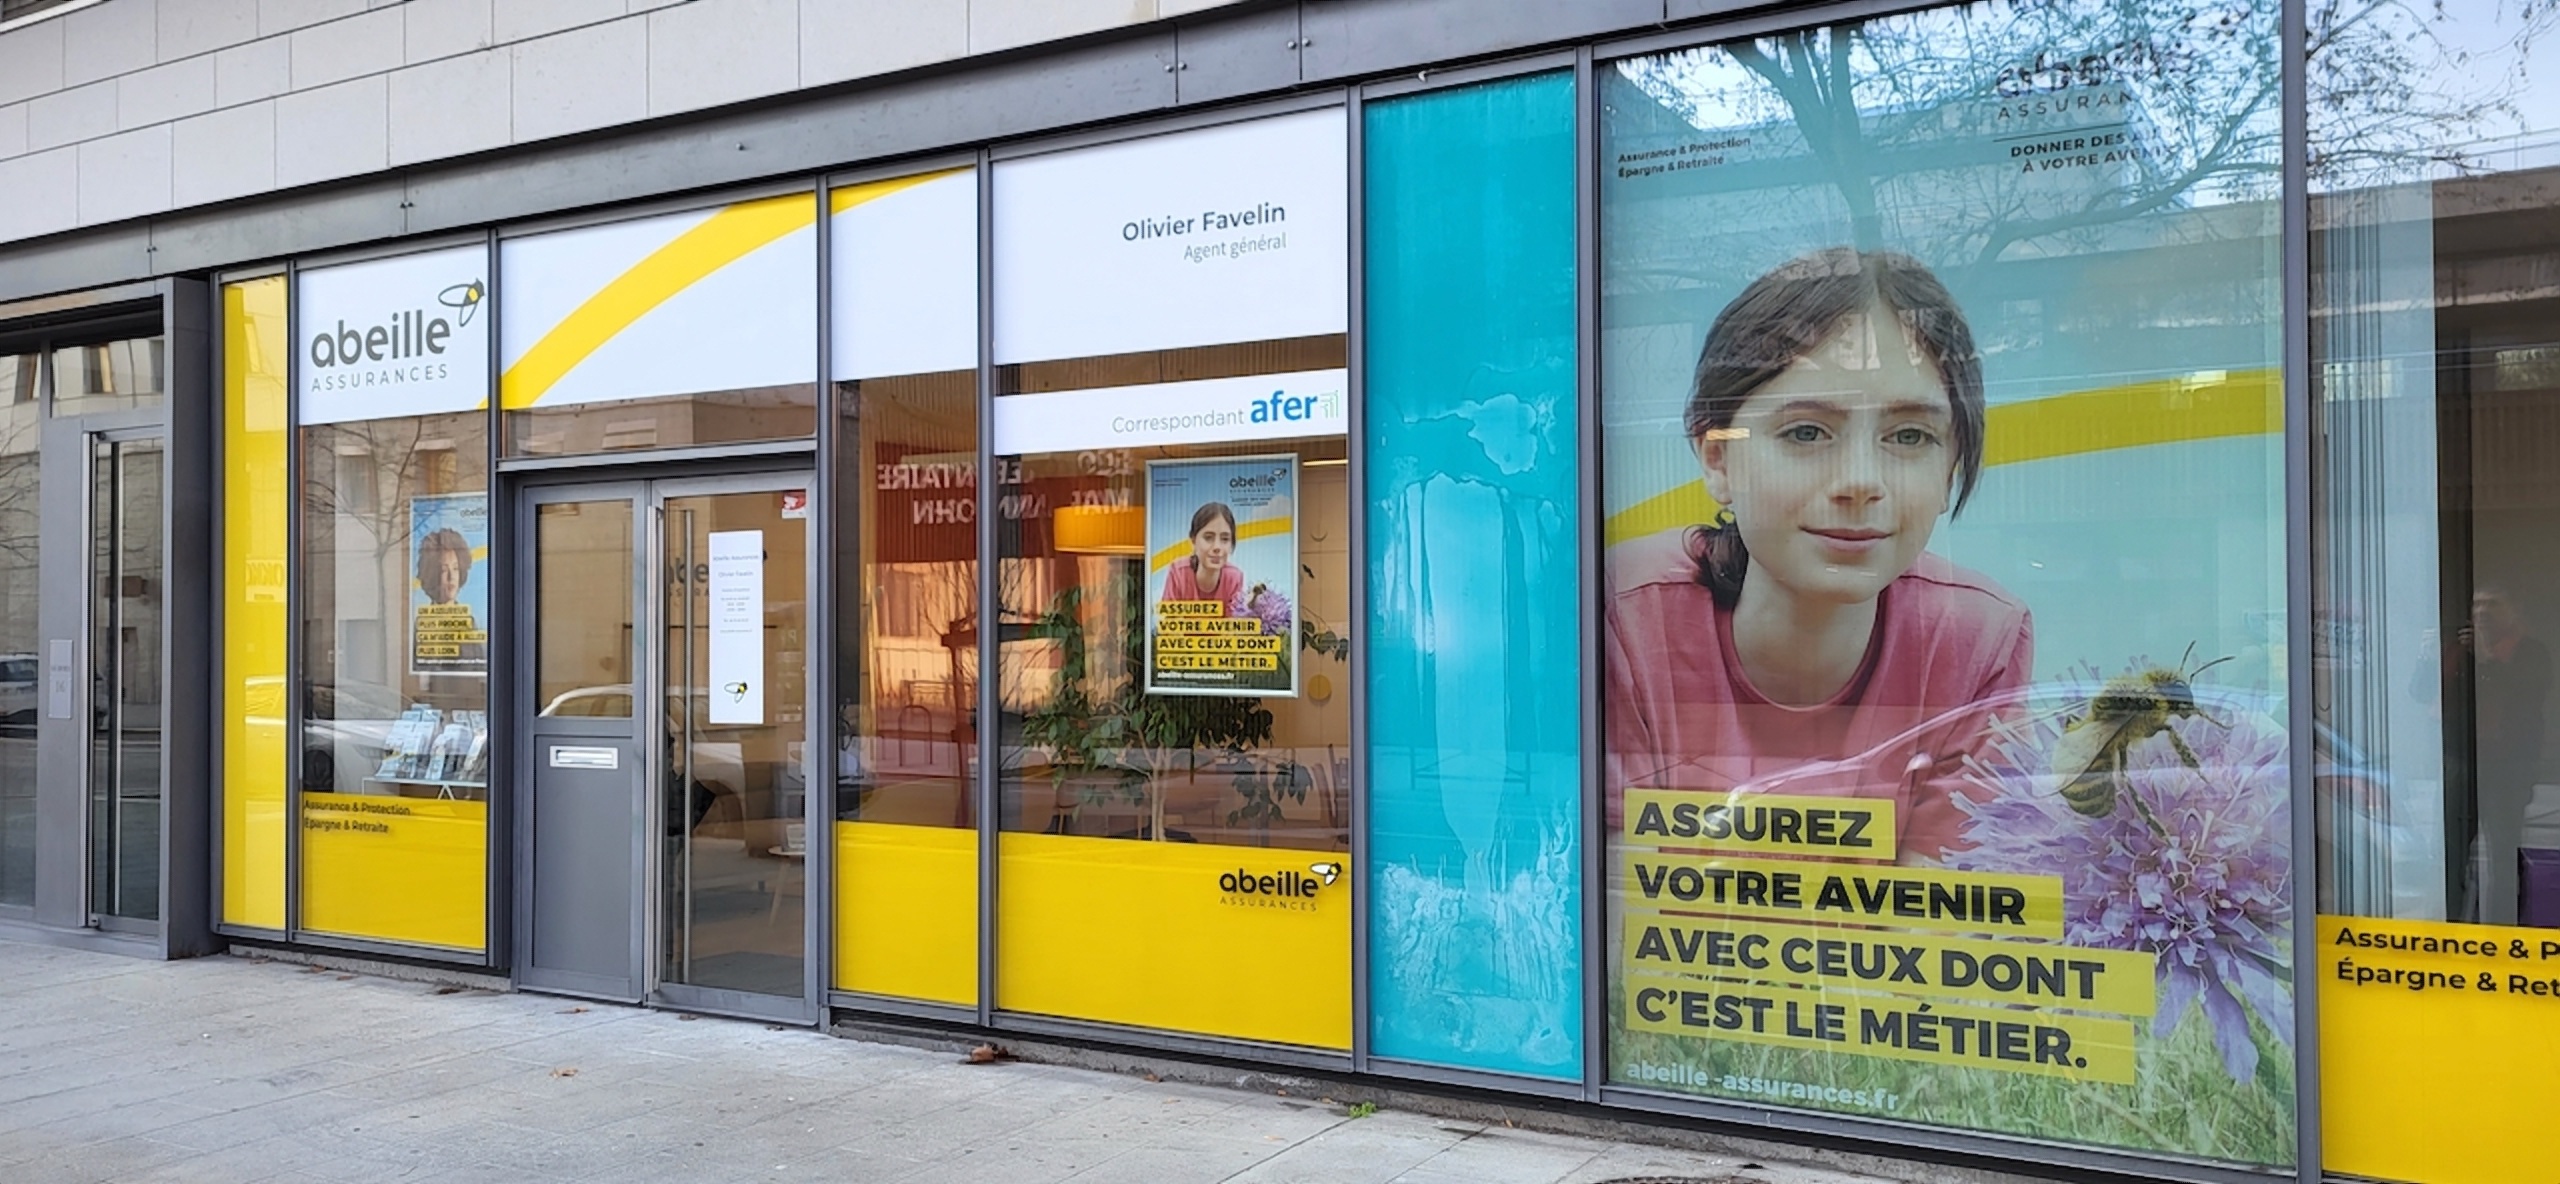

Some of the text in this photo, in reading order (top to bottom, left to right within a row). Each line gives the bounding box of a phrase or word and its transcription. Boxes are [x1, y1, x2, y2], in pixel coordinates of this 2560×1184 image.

[1618, 136, 1751, 164] Assurance & Protection
[2011, 138, 2086, 158] DONNER
[2090, 132, 2126, 148] DES
[1618, 155, 1725, 180] Épargne & Retraite
[2022, 158, 2034, 175] À
[2039, 153, 2100, 171] VOTRE
[1122, 201, 1286, 242] Olivier Favelin
[1184, 231, 1287, 264] Agent général
[311, 308, 451, 369] abeille
[311, 362, 448, 393] ASSURANCES
[1111, 389, 1318, 433] Correspondant afer
[1160, 603, 1219, 615] ASSUREZ
[1159, 620, 1256, 632] VOTRE AVENIR
[1159, 638, 1276, 650] AVEC CEUX DONT
[1199, 656, 1217, 668] LE
[303, 800, 411, 816] Assurance & Protection
[343, 820, 350, 831] &
[352, 820, 389, 833] Retraite
[1634, 801, 1874, 848] ASSUREZ
[1219, 867, 1320, 898] abeille
[1634, 863, 2027, 926] VOTRE AVENIR
[1219, 895, 1318, 912] ASSURANCES
[2335, 927, 2498, 958] Assurance
[2508, 938, 2530, 960] &
[1634, 925, 2106, 1001] AVEC CEUX DONT
[2337, 956, 2467, 992] Épargne
[2476, 971, 2498, 992] &
[1786, 999, 1848, 1043] LE
[1859, 1003, 2088, 1070] MÉTIER.
